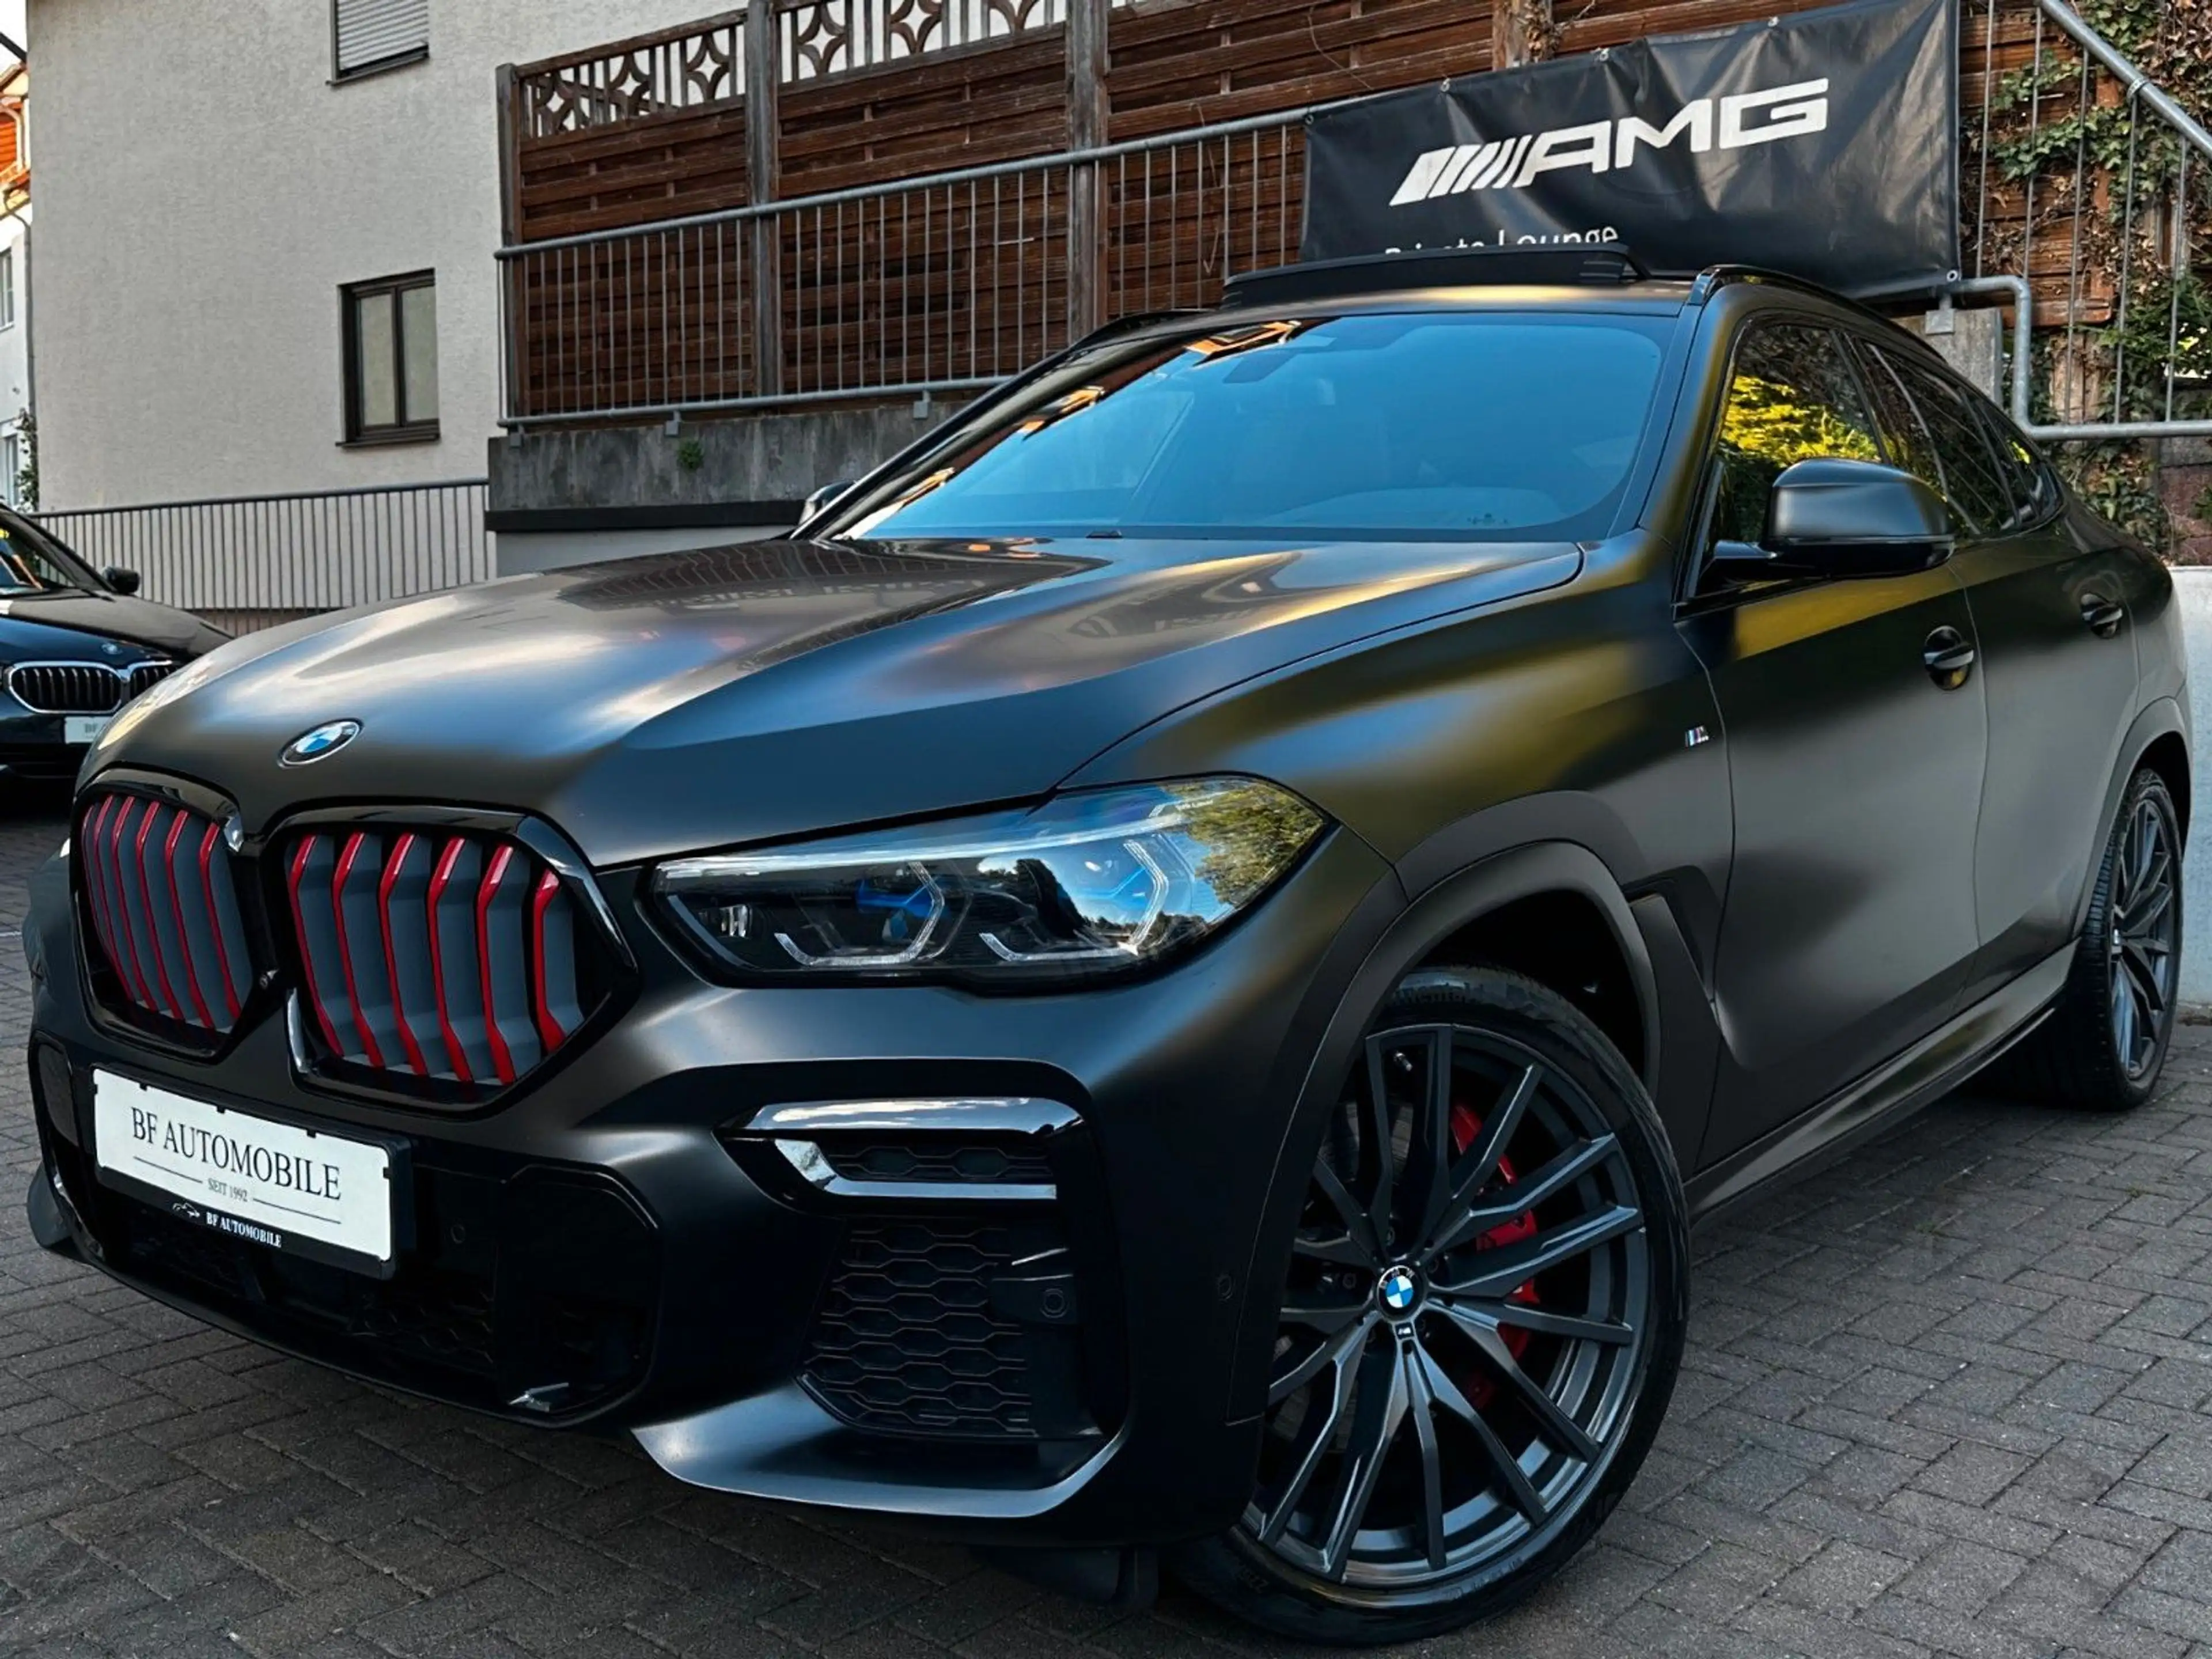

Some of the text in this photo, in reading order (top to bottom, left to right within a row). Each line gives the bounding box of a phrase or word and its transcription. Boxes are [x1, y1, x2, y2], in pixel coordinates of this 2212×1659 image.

[1512, 78, 1829, 188] AMG
[131, 1107, 342, 1200] BF AUTOMOBILE
[208, 1177, 248, 1202] SEIT 1992
[206, 1210, 282, 1248] BF AUTOMOBILE
